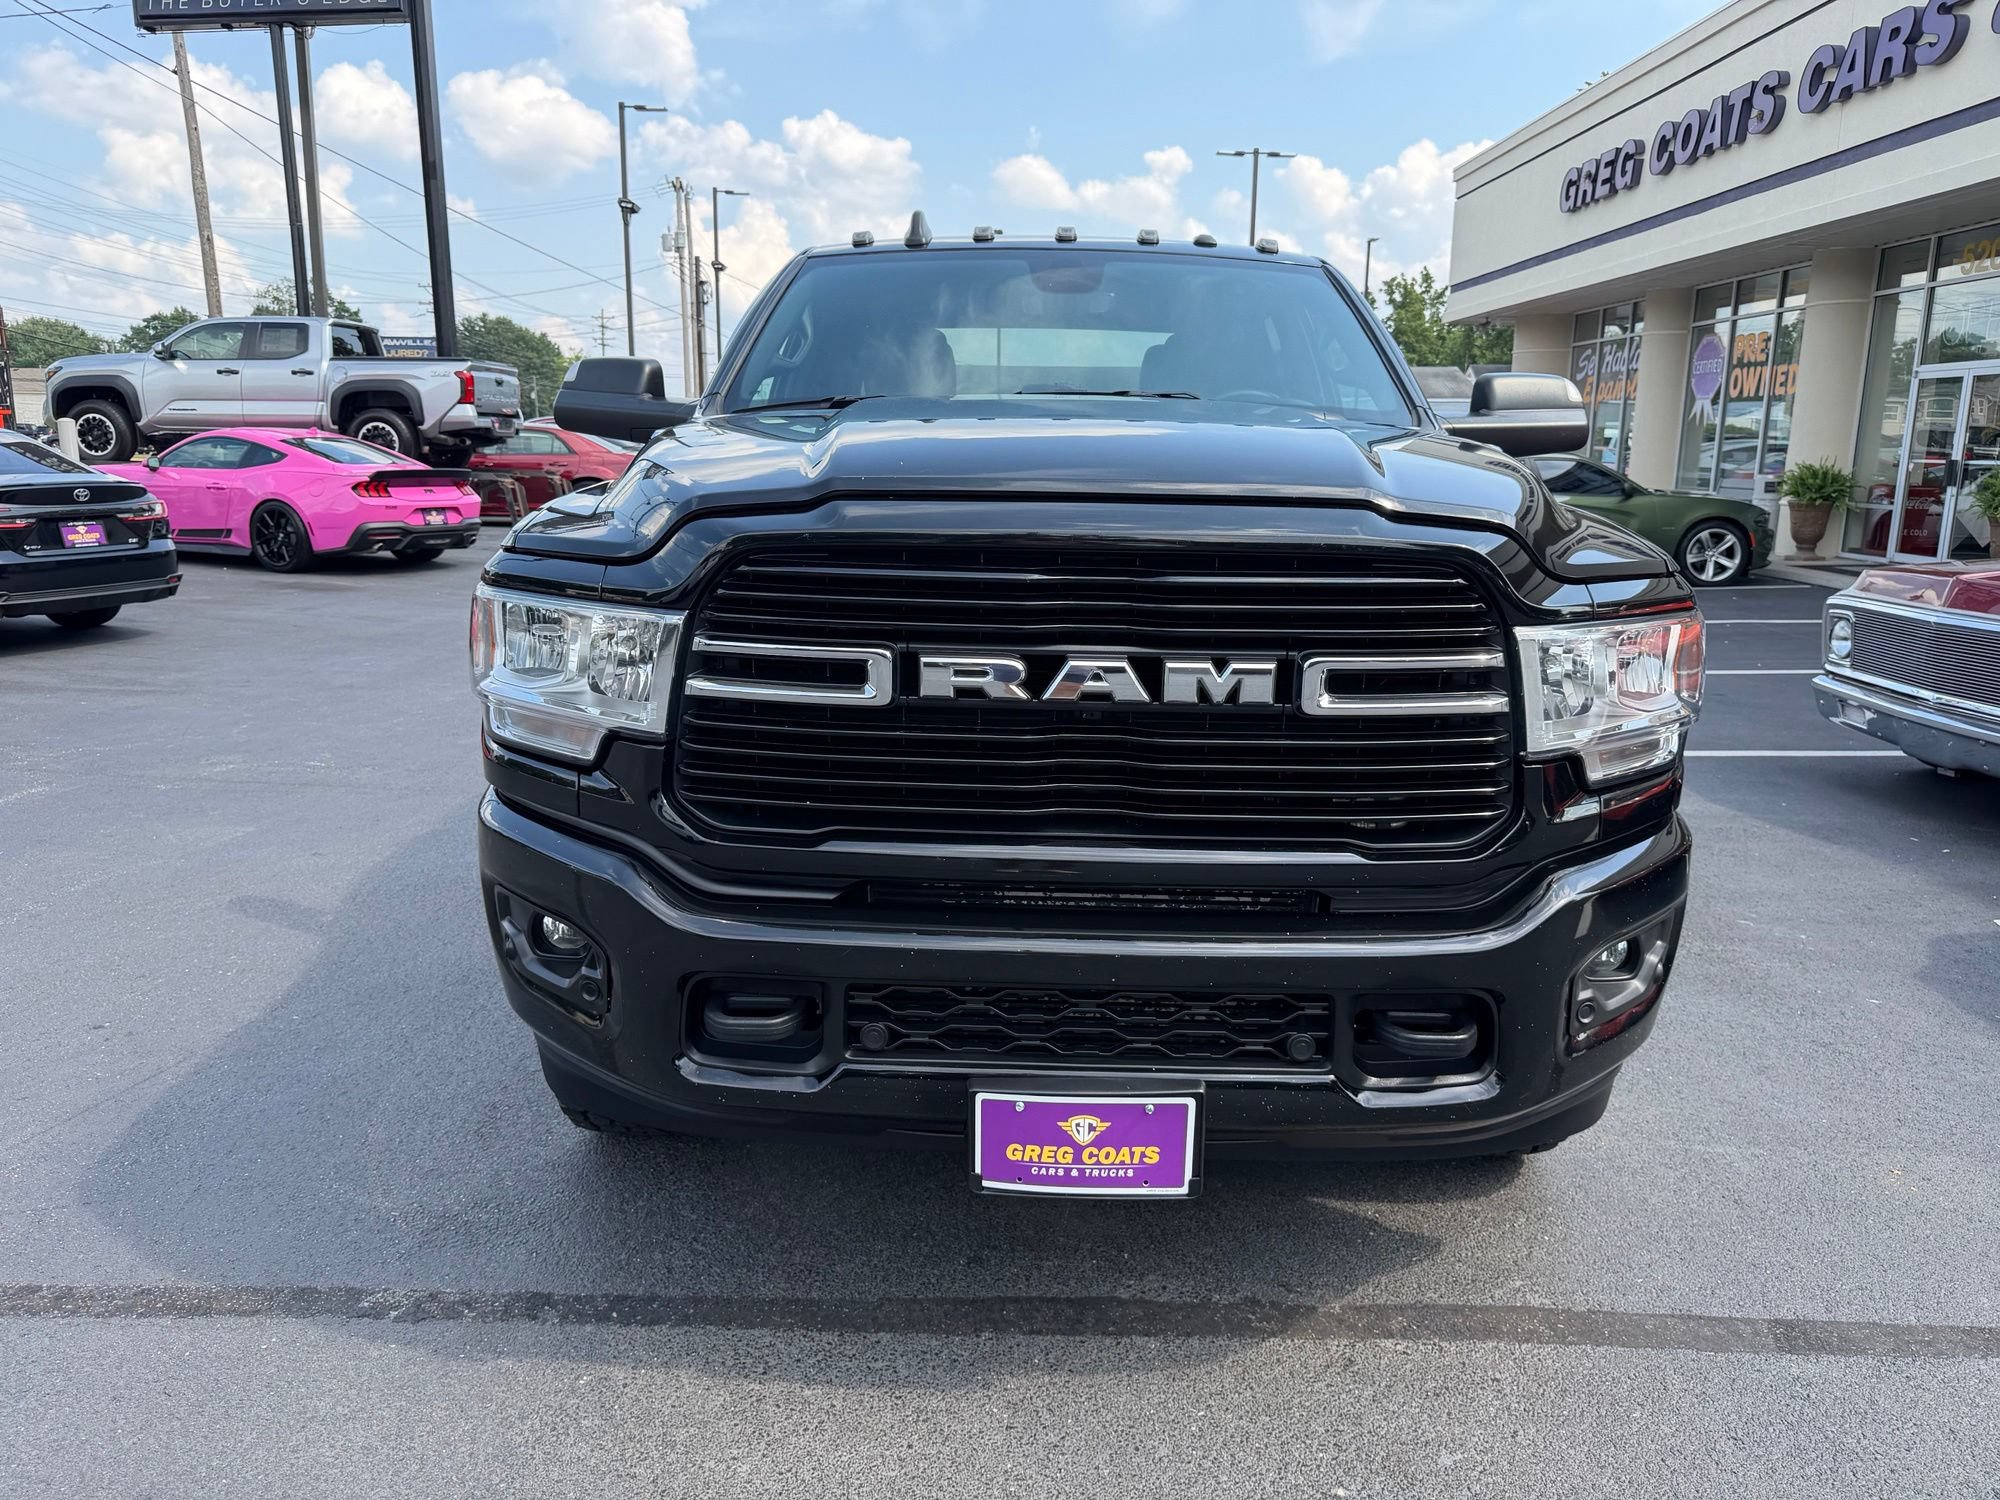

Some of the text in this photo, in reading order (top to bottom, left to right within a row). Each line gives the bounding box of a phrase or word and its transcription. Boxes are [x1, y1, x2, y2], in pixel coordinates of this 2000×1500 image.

[1559, 0, 1974, 213] GREG COATS CARS
[383, 338, 436, 346] AWVILLE
[387, 349, 428, 358] JURED?
[1575, 348, 1597, 381] Se
[1693, 358, 1723, 375] CERTIFIED
[1729, 362, 1799, 398] OWNED
[919, 654, 1278, 704] RAM
[1071, 1117, 1098, 1142] GC
[1006, 1143, 1161, 1165] GREG COATS
[1031, 1166, 1134, 1178] CARS & TRUCKS
